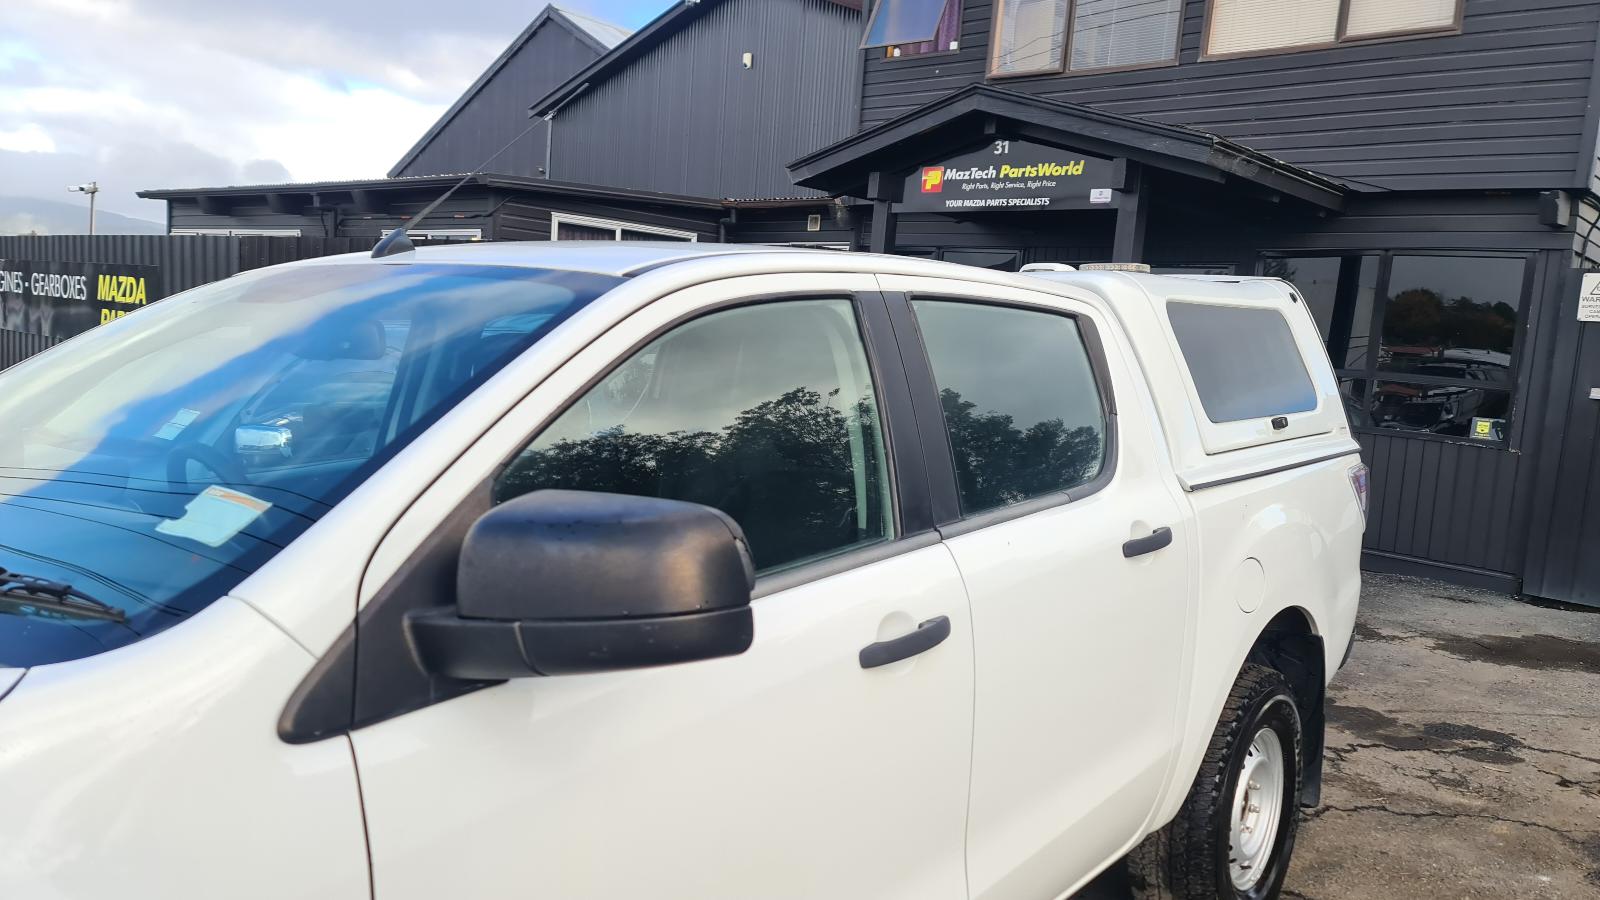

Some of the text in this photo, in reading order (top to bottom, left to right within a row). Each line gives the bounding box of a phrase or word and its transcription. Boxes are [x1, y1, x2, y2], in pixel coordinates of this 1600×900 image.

[994, 140, 1010, 154] 31
[944, 160, 1085, 180] MazTech PartsWorld
[961, 182, 976, 191] Right
[990, 181, 1005, 190] Right
[1027, 180, 1042, 189] Right
[945, 197, 1051, 207] YOUR MAZDA PARTS SPECIALISTS
[31, 272, 87, 300] GEARBOXES
[97, 274, 147, 305] MAZDA
